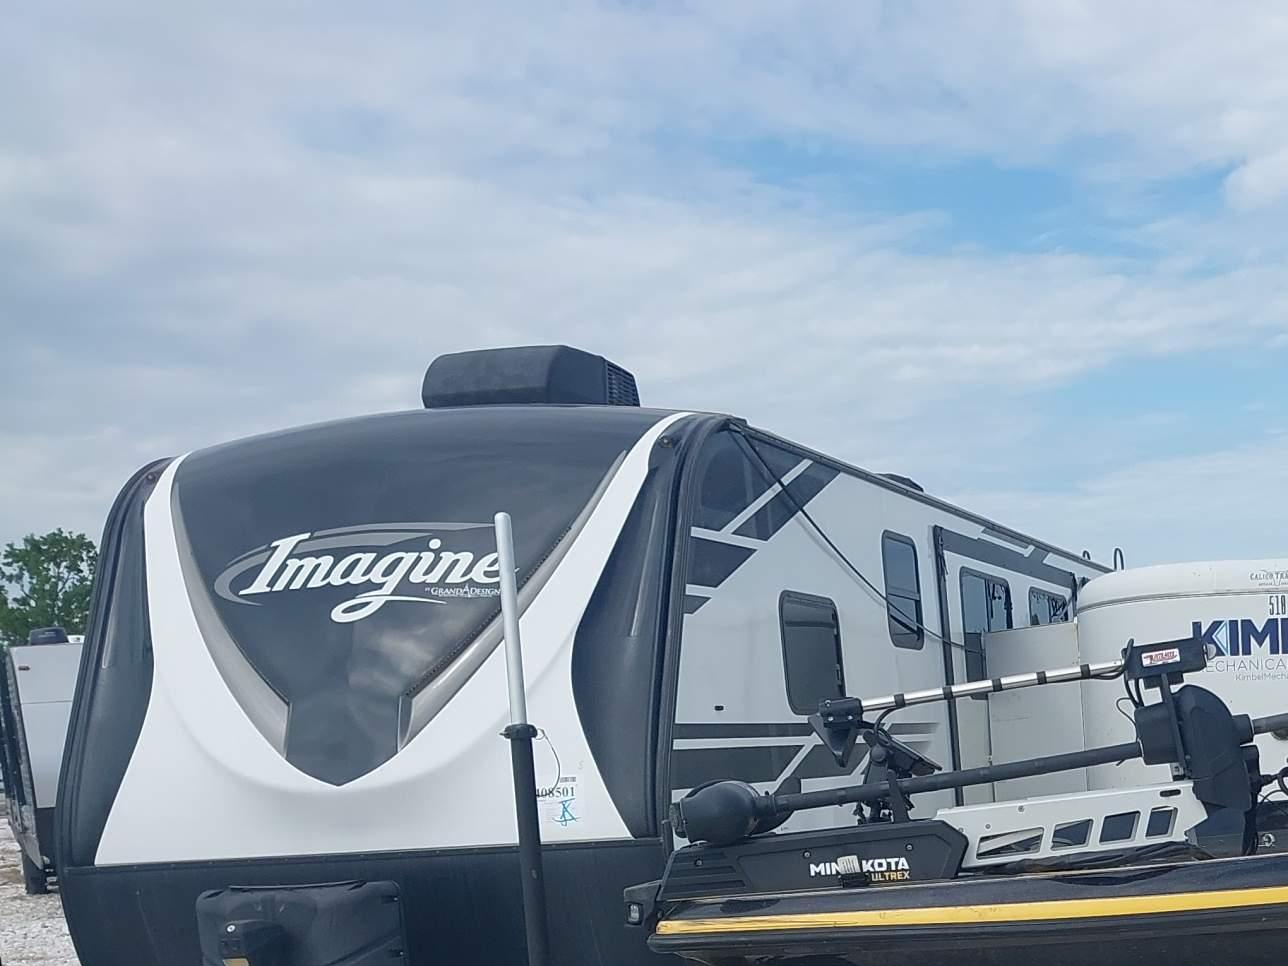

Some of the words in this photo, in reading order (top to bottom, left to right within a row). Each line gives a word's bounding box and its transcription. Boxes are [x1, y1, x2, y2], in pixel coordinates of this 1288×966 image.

[239, 532, 501, 623] Imagine
[1250, 572, 1274, 581] CALICO
[861, 857, 910, 872] KOTA
[871, 870, 910, 881] ULTREX
